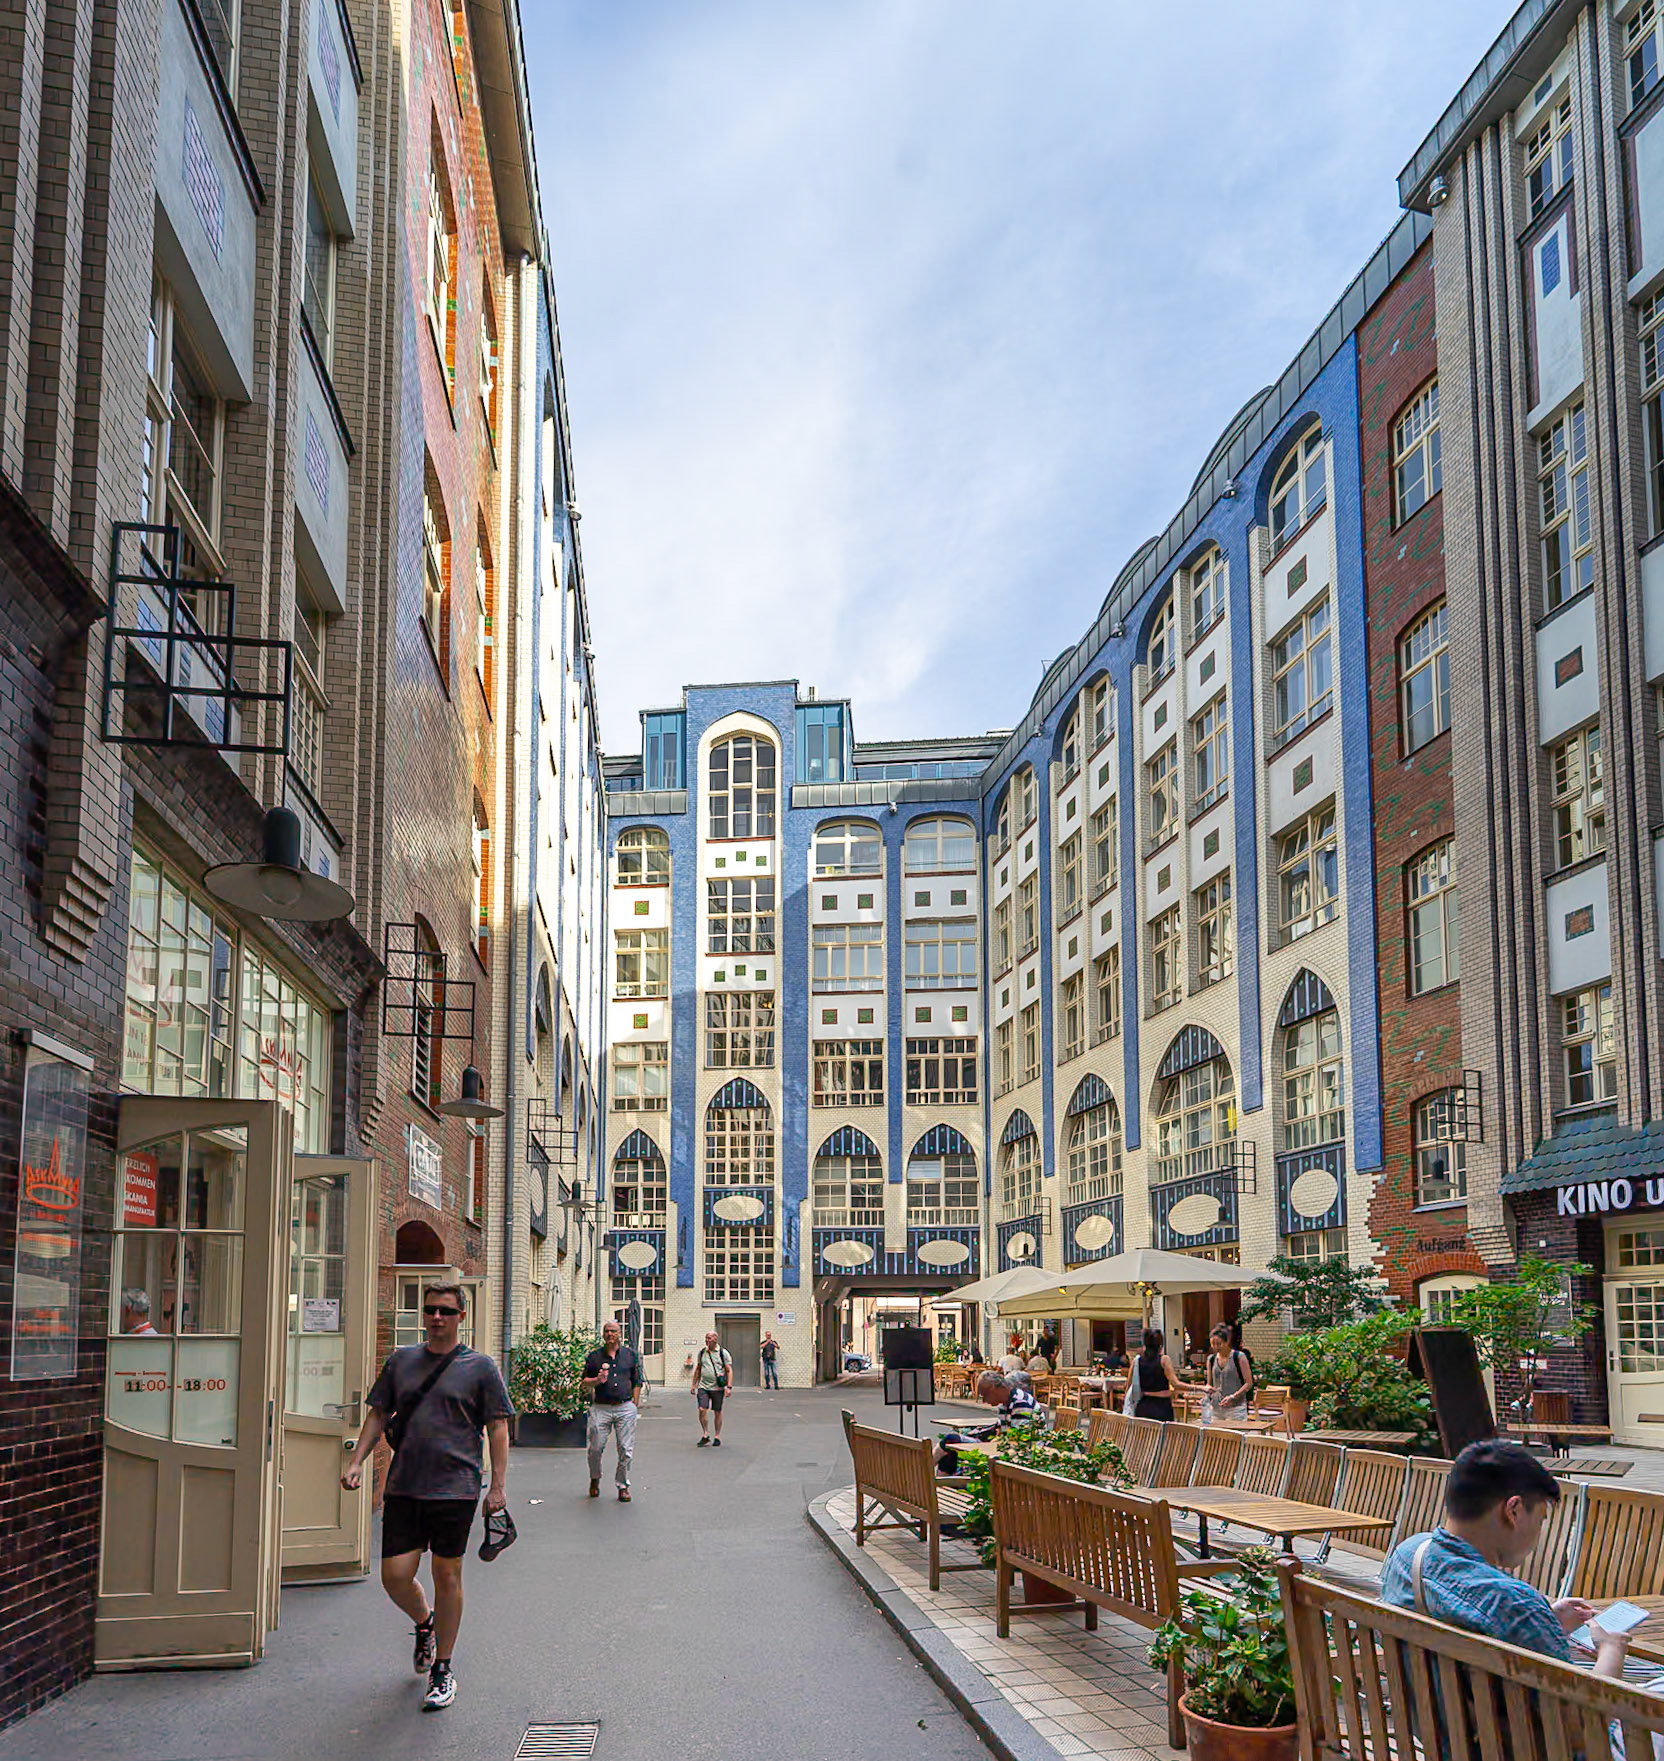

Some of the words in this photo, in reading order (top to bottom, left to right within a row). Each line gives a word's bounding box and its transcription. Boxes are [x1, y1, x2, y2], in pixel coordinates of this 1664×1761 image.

[1557, 1179, 1633, 1216] KINO
[125, 1379, 166, 1392] 11:00
[184, 1379, 226, 1392] 18:00
